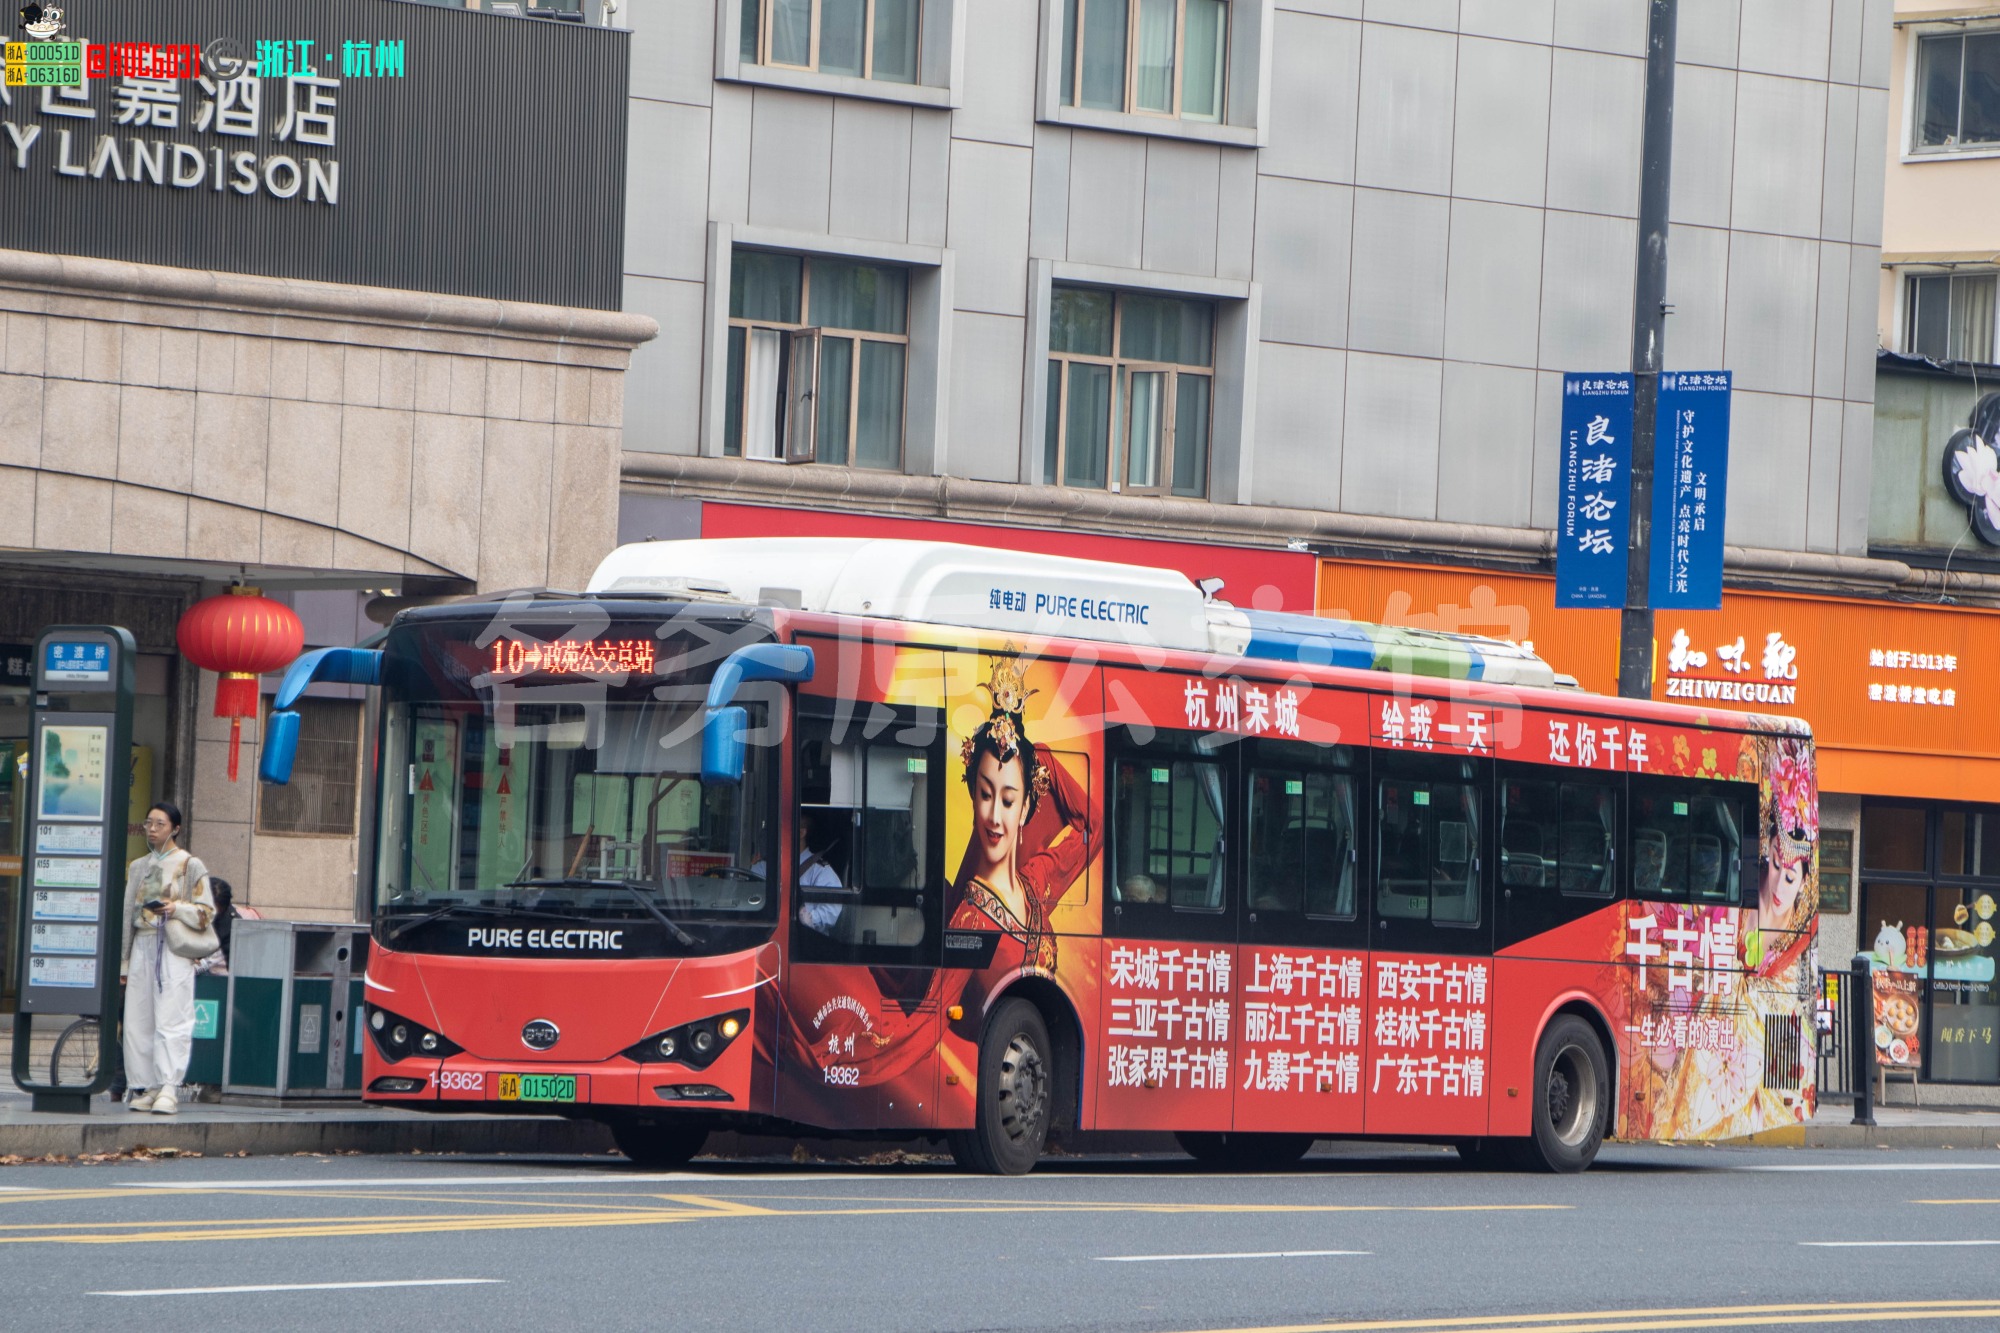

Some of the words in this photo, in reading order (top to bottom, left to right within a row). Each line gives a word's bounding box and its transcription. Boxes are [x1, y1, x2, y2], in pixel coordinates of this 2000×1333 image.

[57, 129, 339, 205] LANDISON
[1567, 430, 1578, 492] LIANGZHU
[1679, 409, 1695, 498] 守护文化遗产
[1578, 414, 1618, 555] 良渚论坛
[1693, 472, 1708, 532] 文明承启
[1566, 495, 1576, 538] FORUM
[1675, 504, 1692, 594] 点亮时代之光
[989, 588, 1027, 612] 纯电动
[1035, 593, 1077, 618] PURE
[1080, 598, 1150, 626] ELECTRIC
[543, 640, 655, 674] 政苑公交总站
[1184, 678, 1300, 738] 杭州宋城
[1666, 678, 1797, 705] ZHIWEIGUAN
[1382, 700, 1489, 755] 给我一天
[1548, 719, 1650, 773] 还你千年
[468, 928, 523, 949] PURE
[527, 928, 623, 950] ELECTRIC
[1626, 913, 1738, 996] 千古情
[1109, 945, 1232, 994] 宋城千古情
[1245, 952, 1363, 1000] 上海千古情
[1375, 960, 1488, 1005] 西安千古情
[525, 1028, 555, 1041] BYD
[1108, 996, 1231, 1042] 三亚千古情
[1244, 1001, 1362, 1047] 丽江千古情
[1374, 1006, 1487, 1051] 桂林千古情
[1624, 1014, 1735, 1051] 一生必看的演出
[828, 1032, 856, 1058] 杭州
[1107, 1044, 1229, 1090] 张家界千古情
[428, 1070, 483, 1091] 1-9362
[822, 1064, 860, 1086] 1-9362
[1243, 1049, 1360, 1095] 九寨千古情
[1372, 1053, 1485, 1098] 广东千古情
